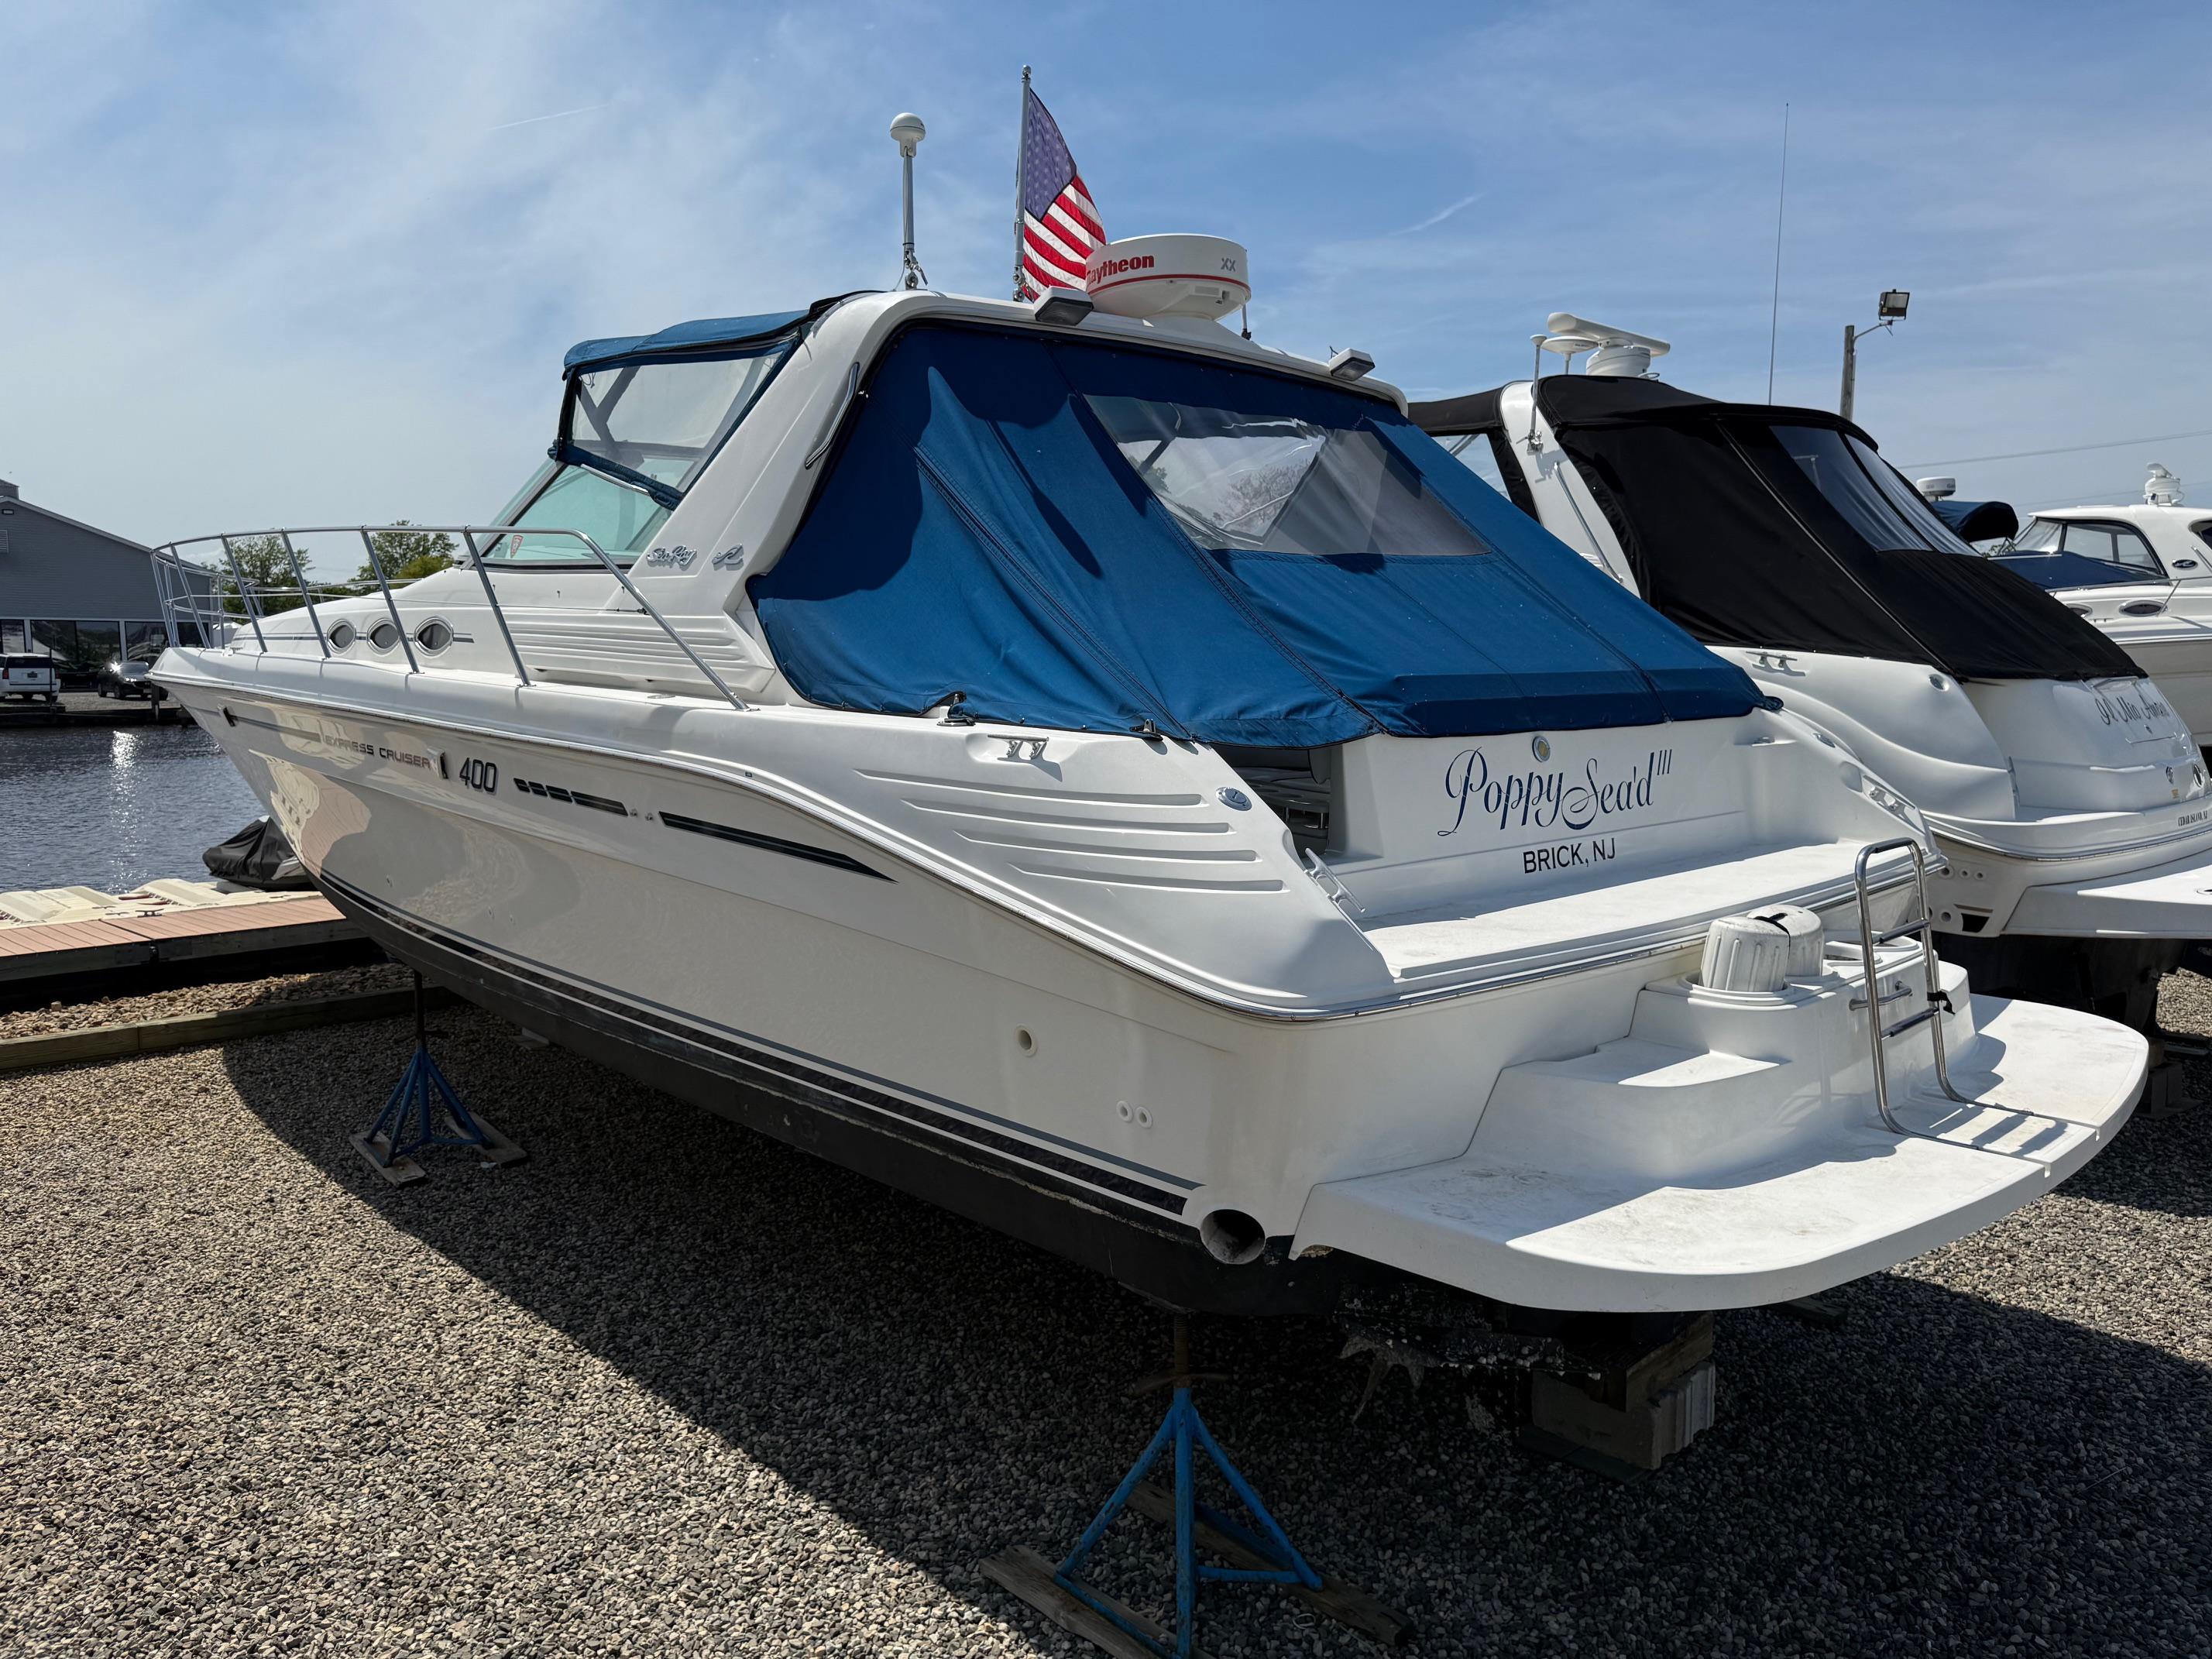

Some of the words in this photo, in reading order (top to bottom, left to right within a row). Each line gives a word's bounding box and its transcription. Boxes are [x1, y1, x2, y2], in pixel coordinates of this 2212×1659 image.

[325, 734, 375, 756] EXPRESS
[379, 747, 431, 769] CRUISER
[459, 757, 498, 793] 400
[1437, 747, 1564, 836] Poppy
[1523, 843, 1590, 874] BRICK,
[1593, 837, 1616, 860] NJ
